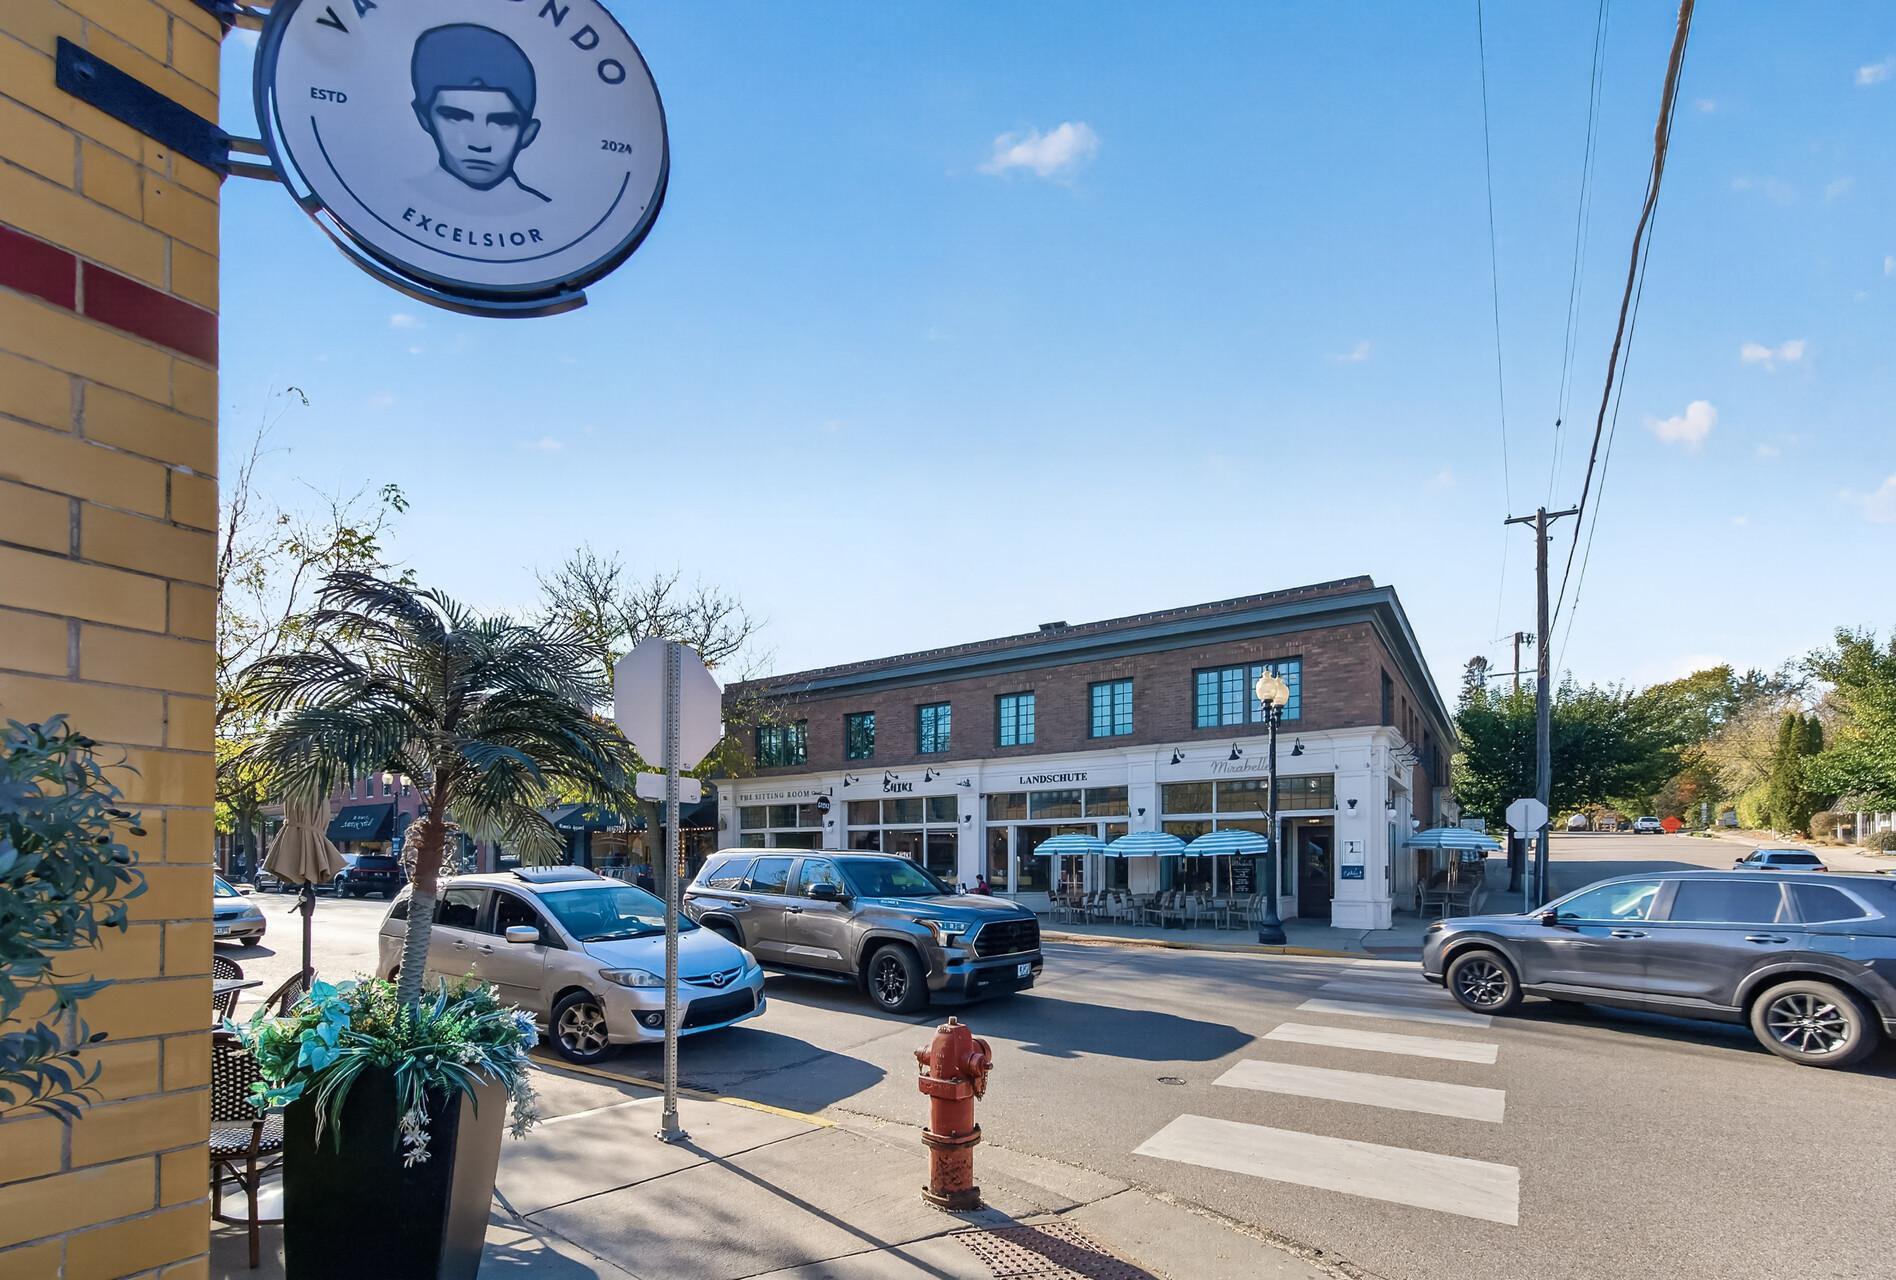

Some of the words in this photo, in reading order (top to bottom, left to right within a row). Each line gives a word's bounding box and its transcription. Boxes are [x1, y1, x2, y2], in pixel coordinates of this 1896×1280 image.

[310, 87, 348, 103] ESTD
[601, 139, 633, 155] 2024
[402, 207, 544, 248] EXCELSIOR
[1019, 772, 1088, 785] LANDSCHUTE
[882, 782, 913, 793] SHIKI
[755, 791, 784, 800] SITTING
[787, 790, 810, 798] ROOM
